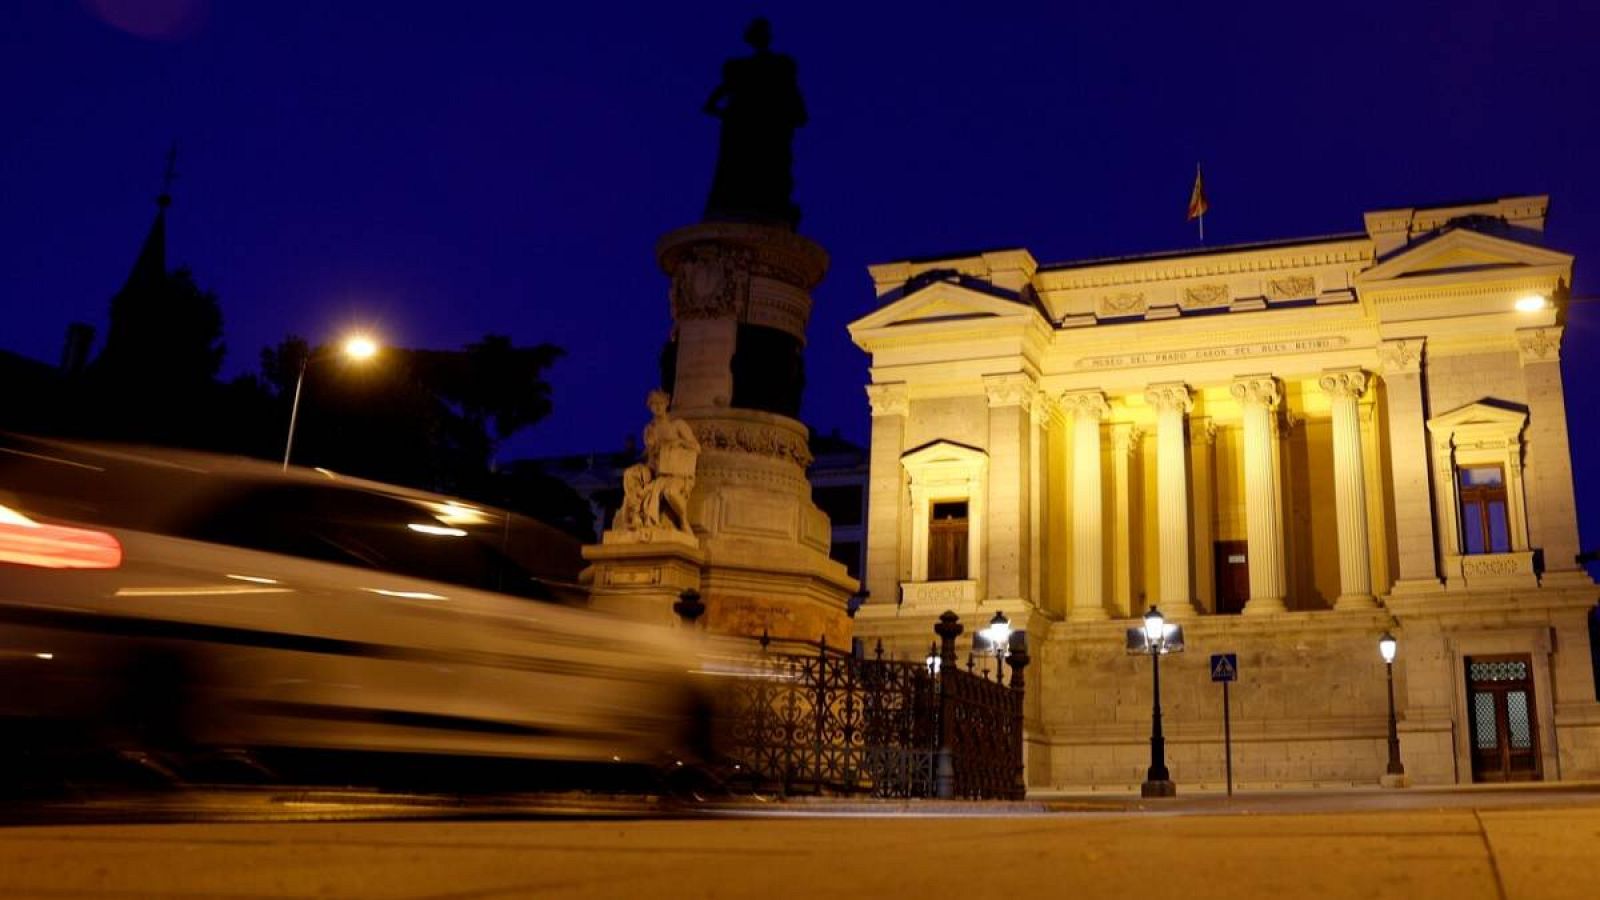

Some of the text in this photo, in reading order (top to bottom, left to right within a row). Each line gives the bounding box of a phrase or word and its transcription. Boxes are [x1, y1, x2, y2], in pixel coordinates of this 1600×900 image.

[1130, 356, 1147, 364] DEL
[1156, 353, 1187, 362] PRADO
[1234, 347, 1251, 356] DEL
[1295, 341, 1329, 350] RETIRO
